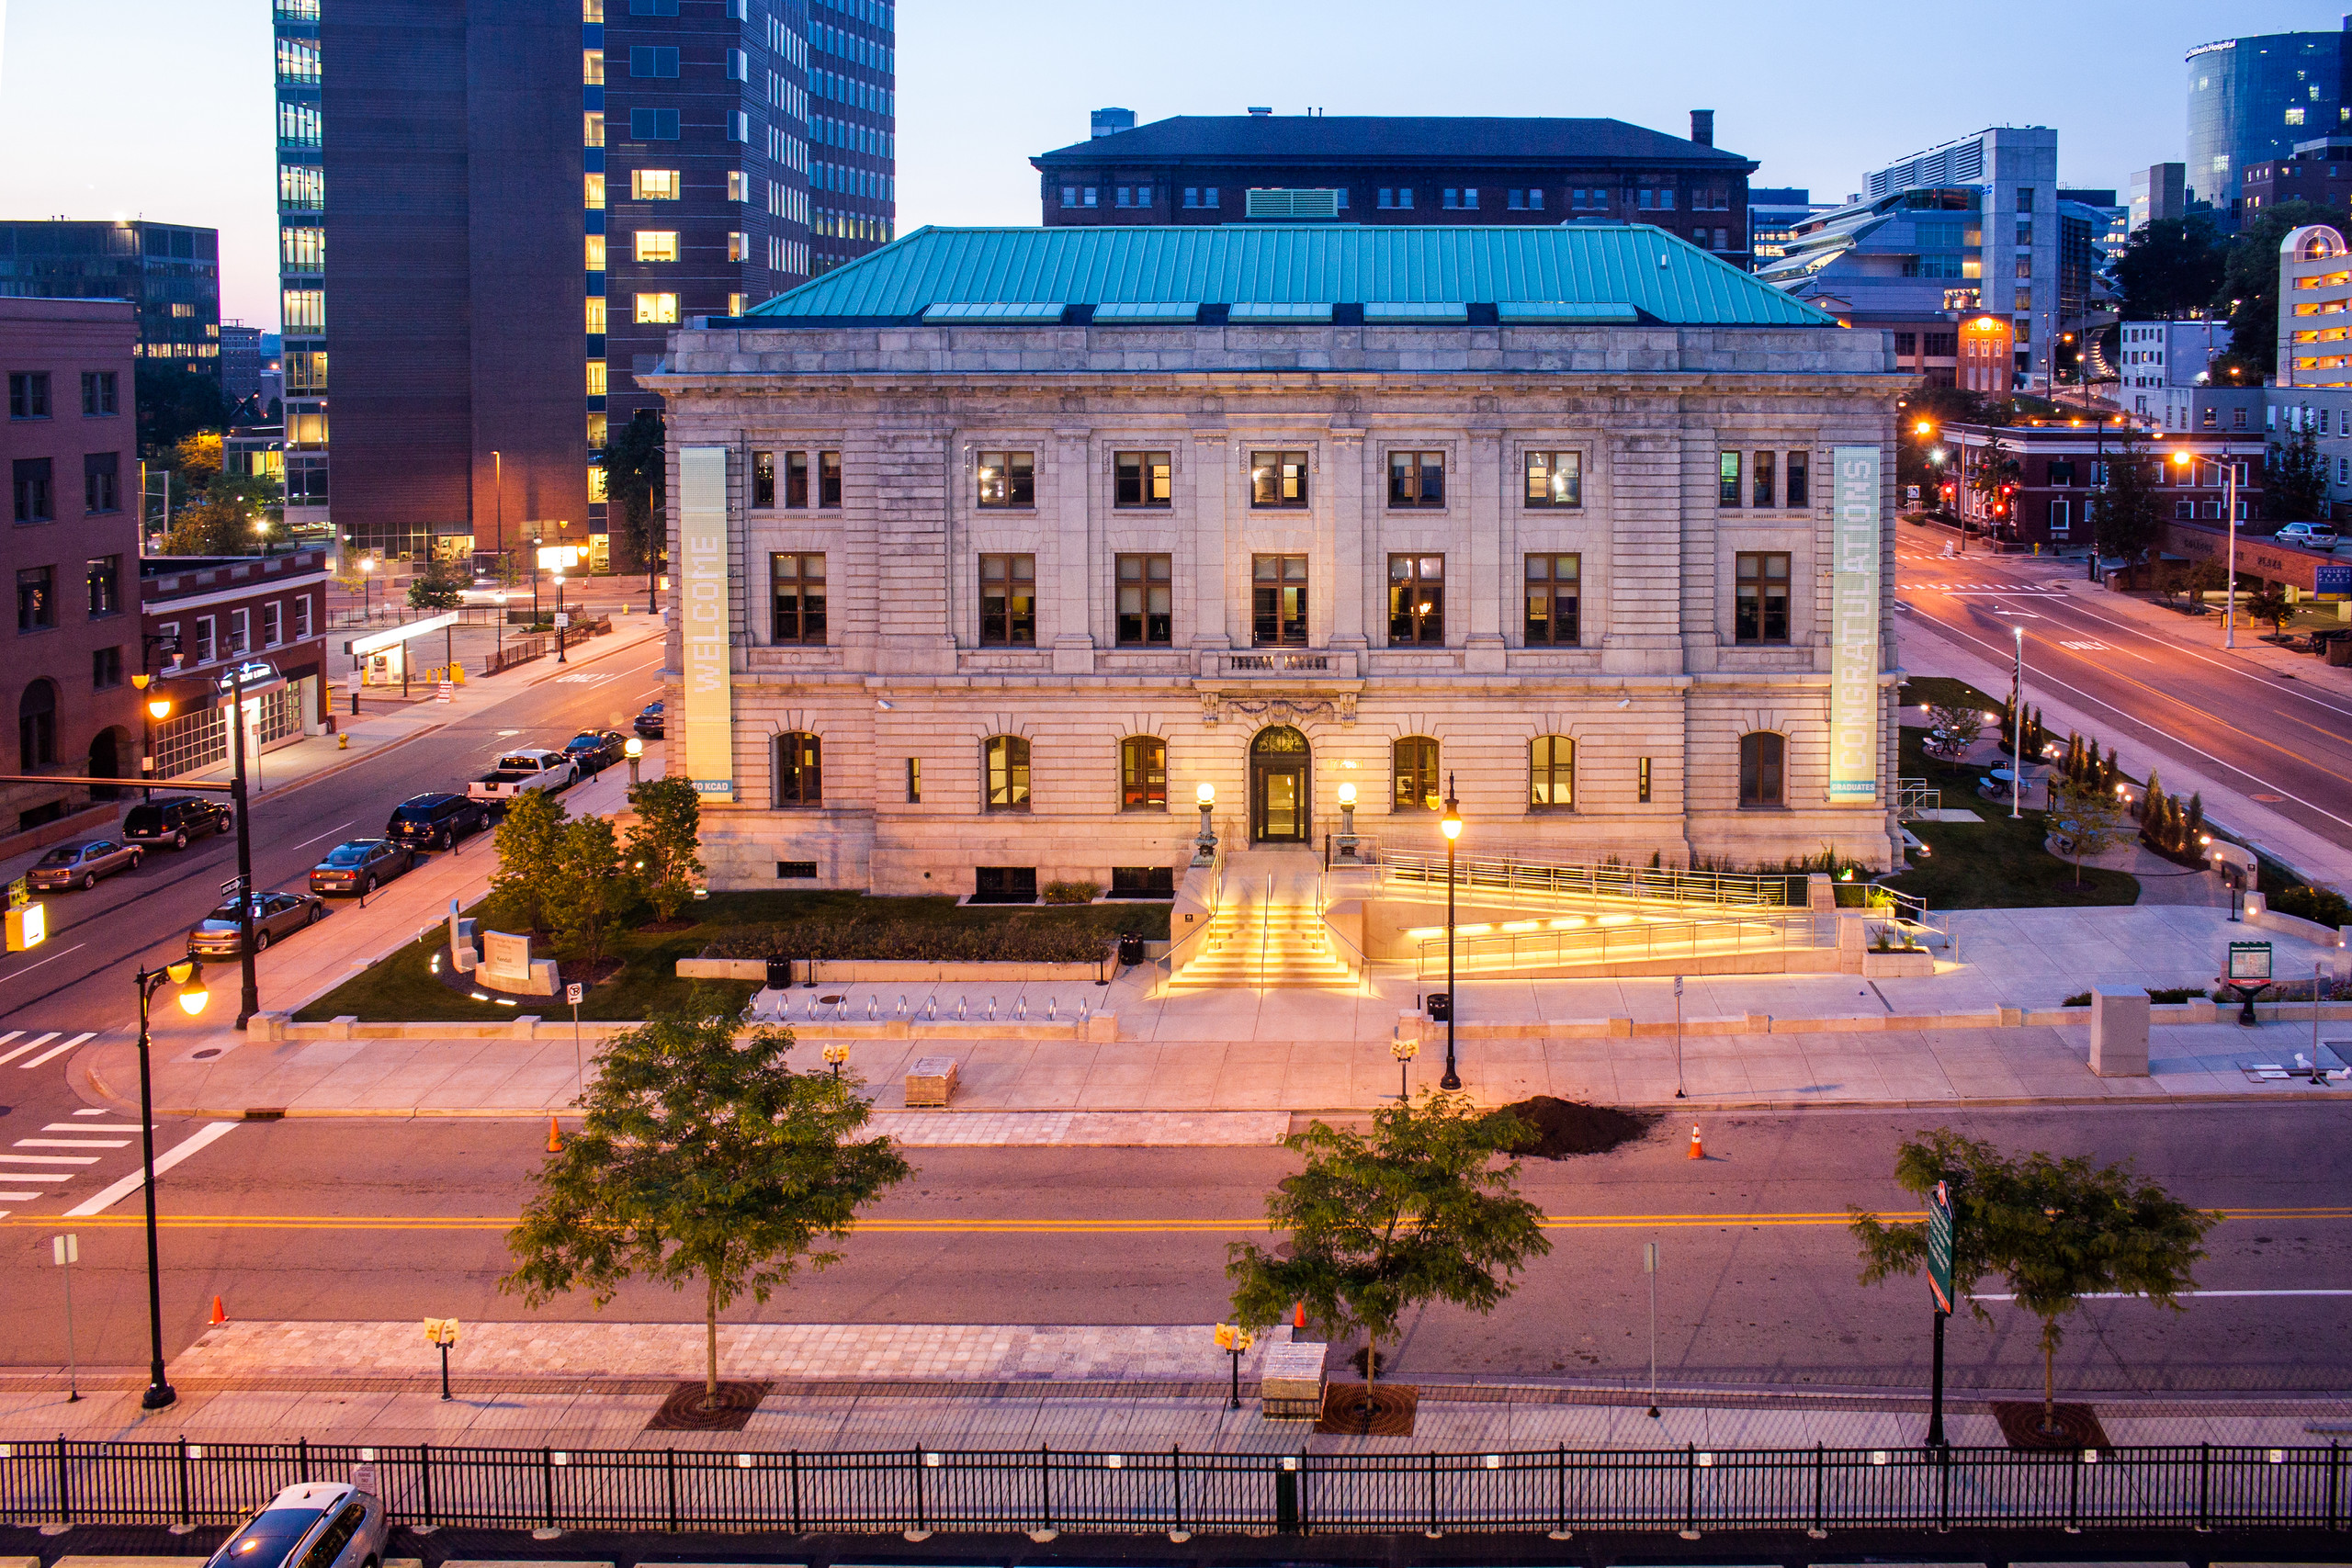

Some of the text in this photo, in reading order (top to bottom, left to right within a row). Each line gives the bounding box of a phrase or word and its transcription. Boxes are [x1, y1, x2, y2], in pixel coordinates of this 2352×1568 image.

[691, 537, 720, 693] WELCOME
[1840, 459, 1871, 770] CONGRATULATIONS
[2059, 640, 2110, 649] ONLY
